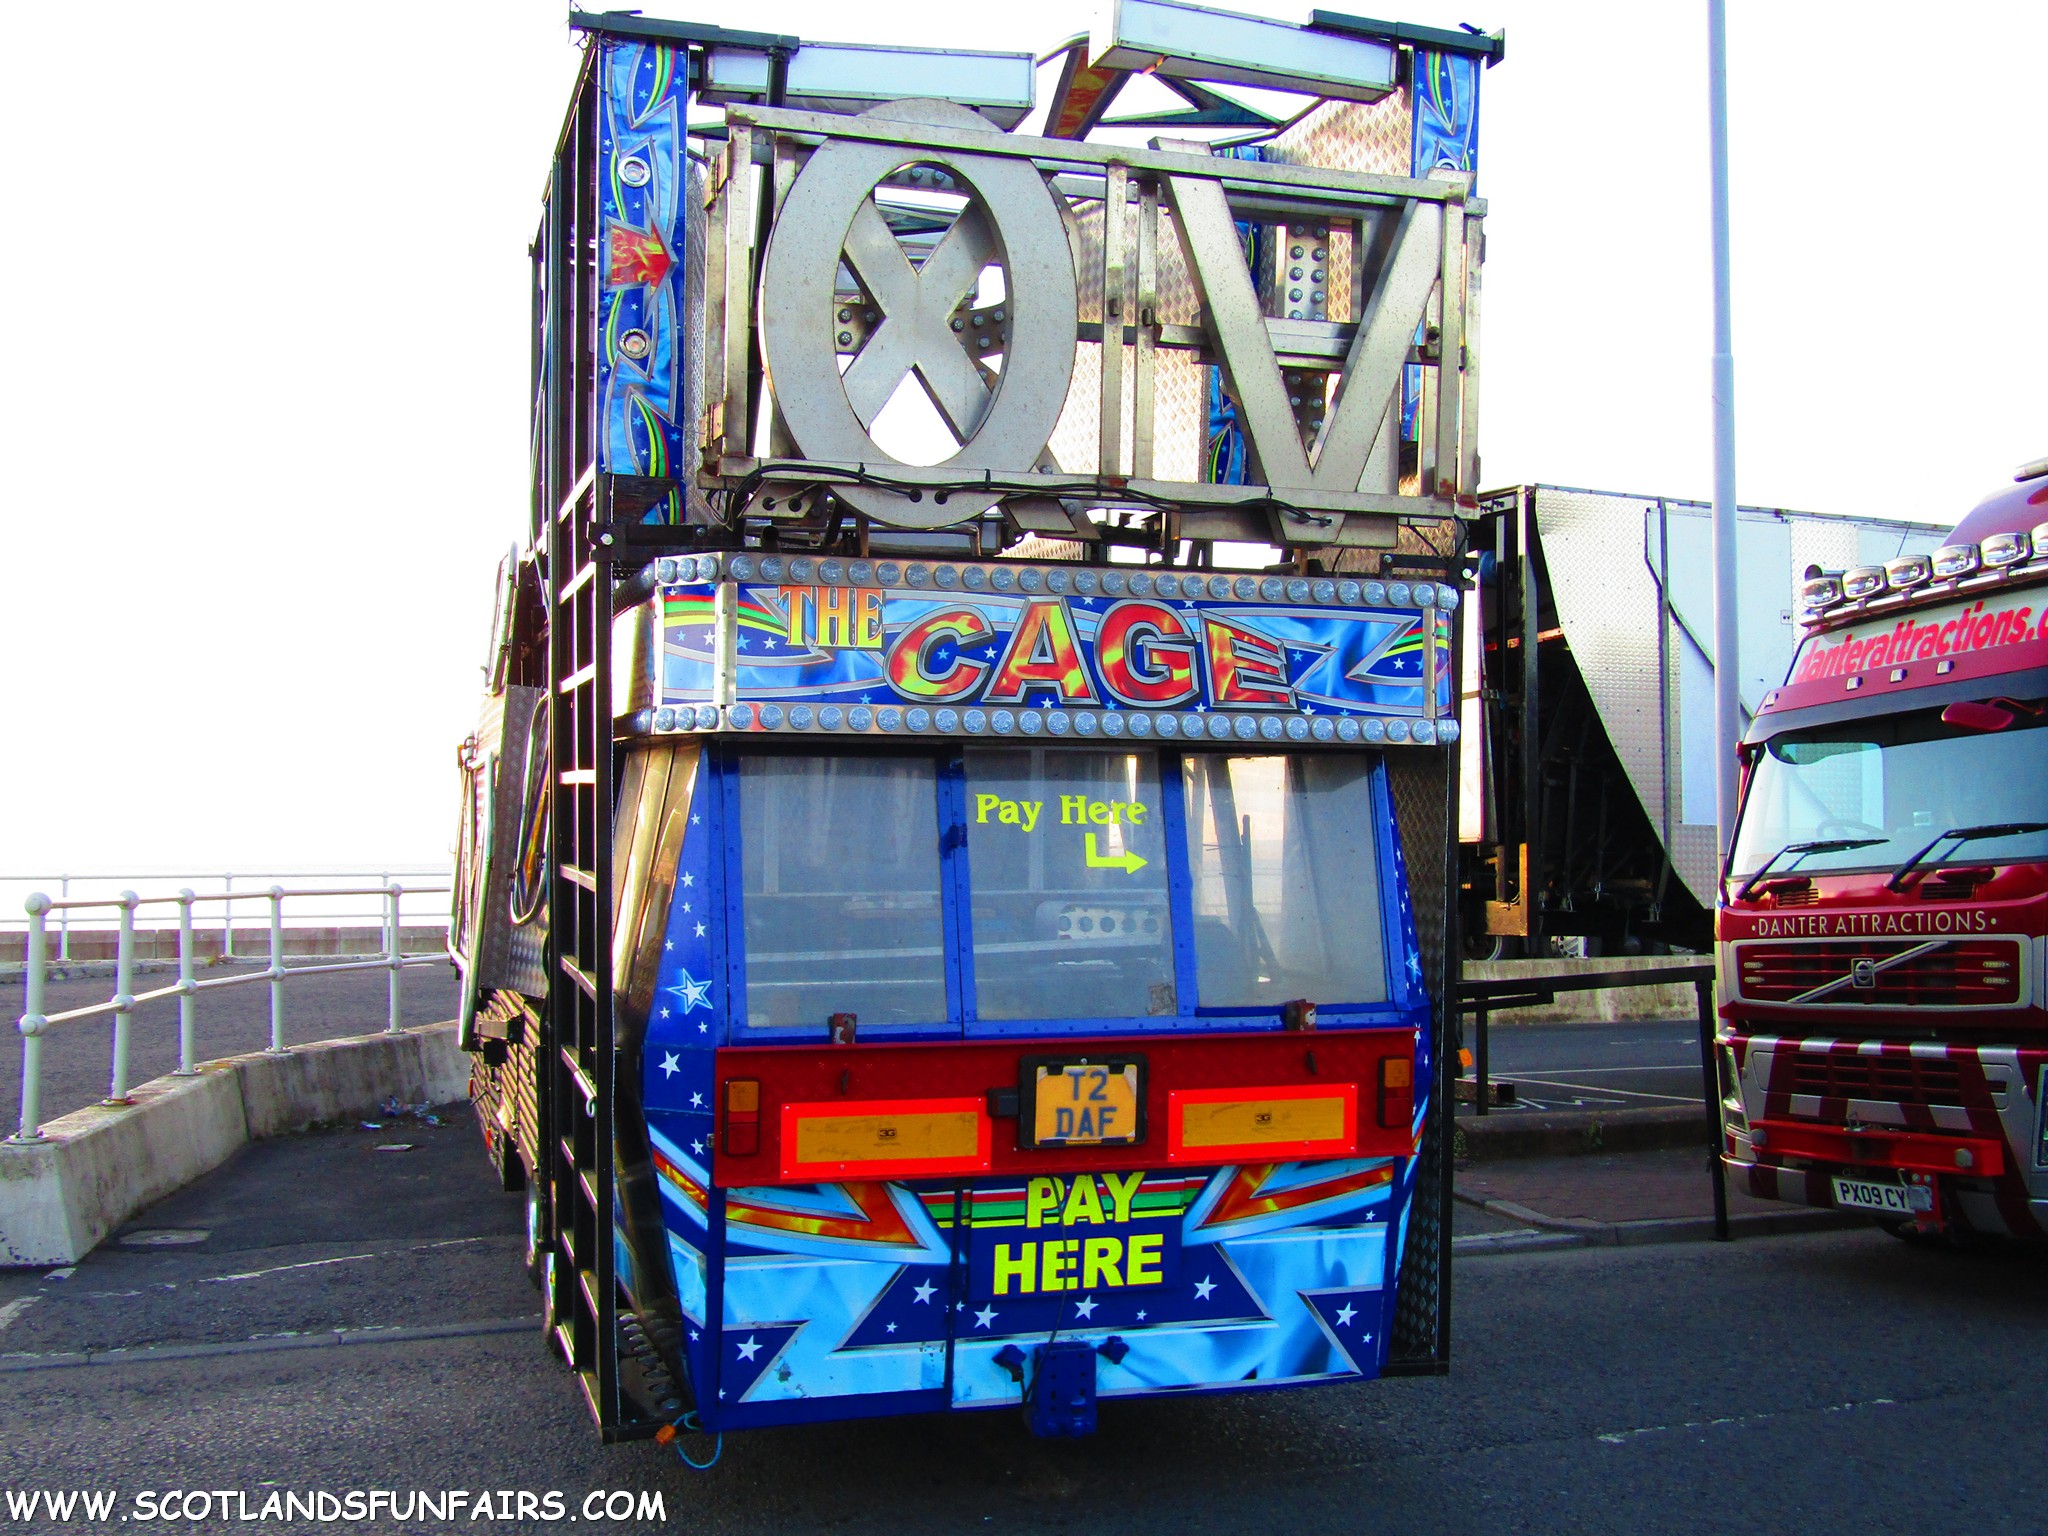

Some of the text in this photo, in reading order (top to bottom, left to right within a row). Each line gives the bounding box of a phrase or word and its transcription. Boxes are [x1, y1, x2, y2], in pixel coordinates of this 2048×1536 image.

[778, 585, 1297, 710] THE CAGE
[975, 793, 1148, 832] Pay Here
[1758, 911, 1986, 936] DANTER ATTRACTIONS
[1067, 1069, 1109, 1101] T2
[1055, 1106, 1117, 1138] DAF
[1026, 1171, 1146, 1228] PAY
[1839, 1182, 1906, 1208] PX09 CY
[993, 1233, 1164, 1295] HERE
